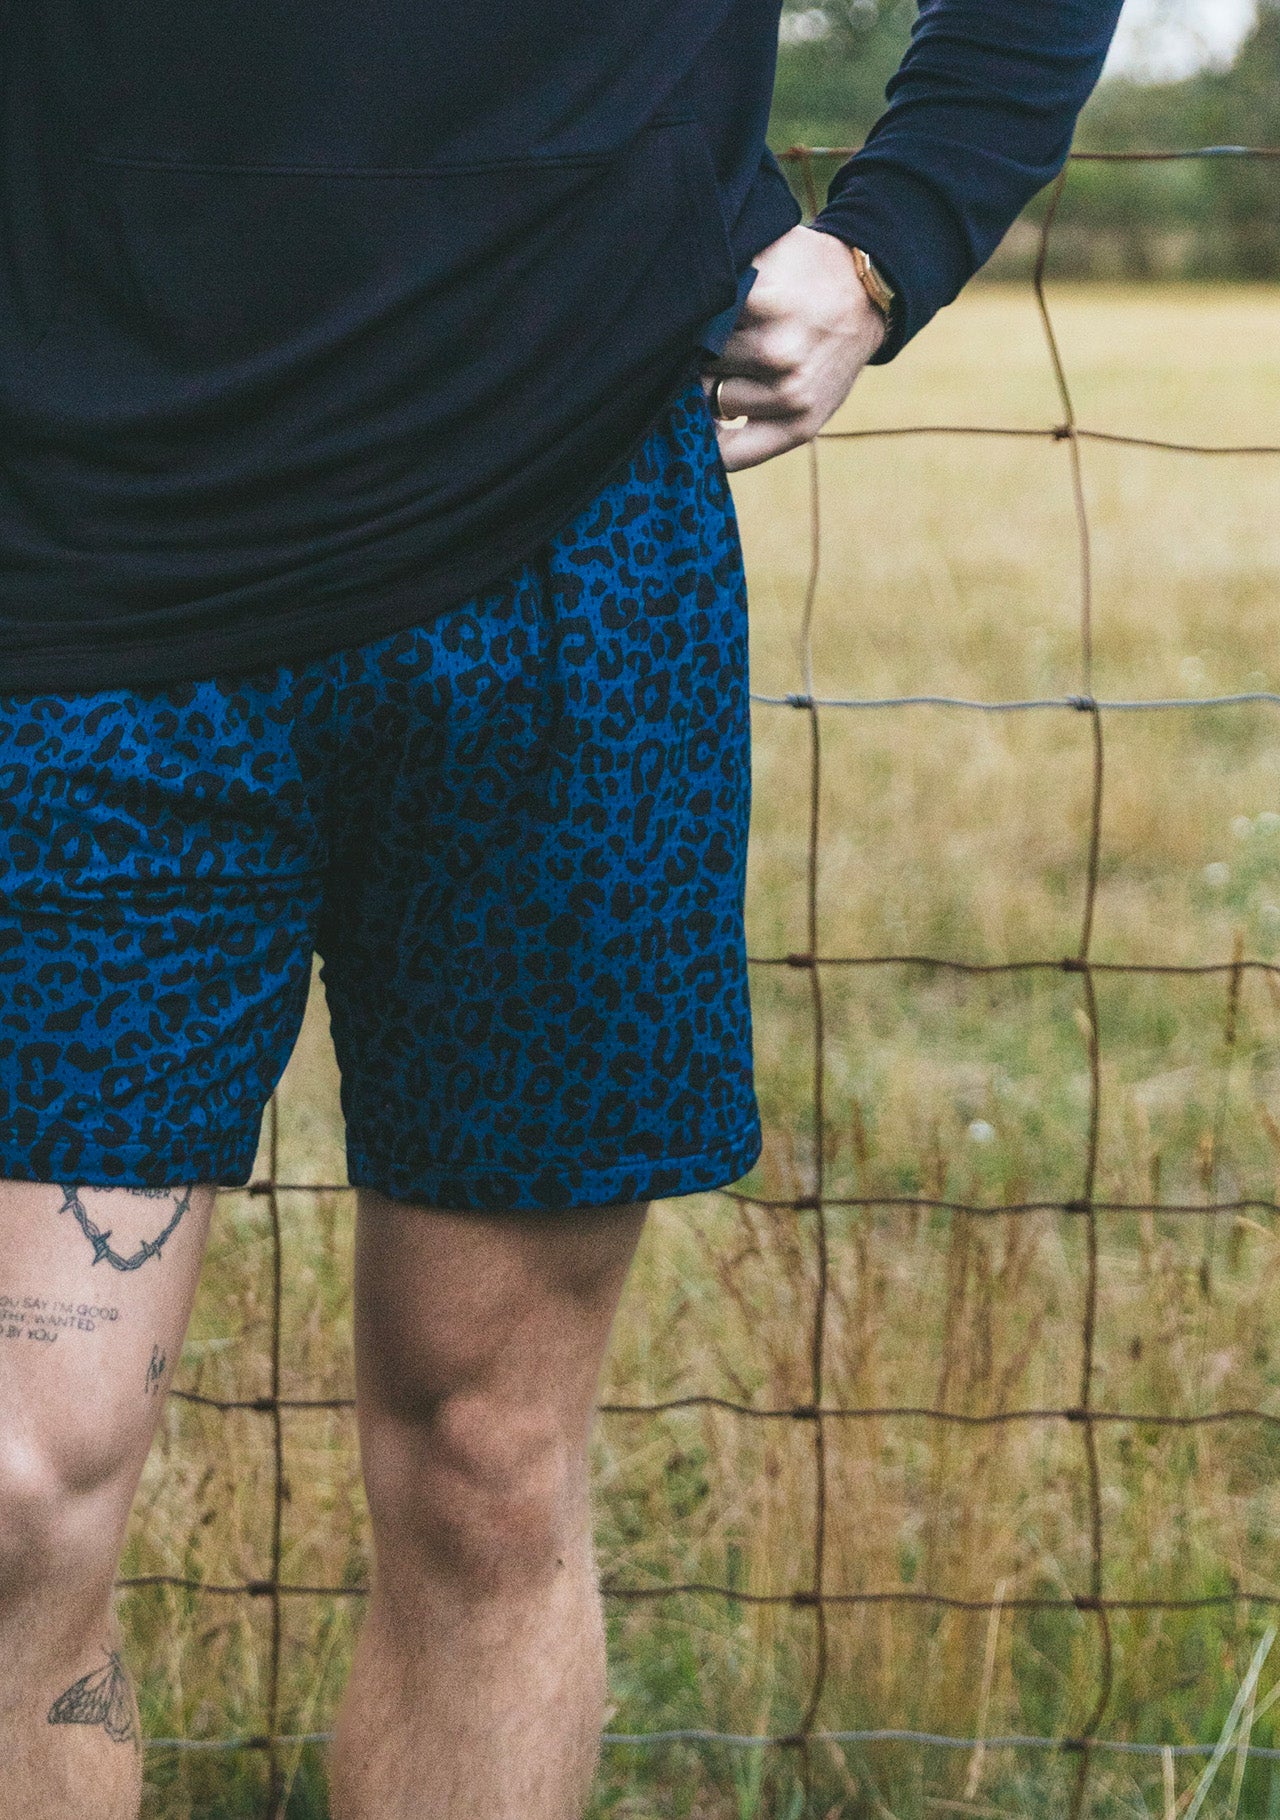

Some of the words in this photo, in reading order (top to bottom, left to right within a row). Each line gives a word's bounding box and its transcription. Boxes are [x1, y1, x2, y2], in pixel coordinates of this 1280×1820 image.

[23, 1297, 48, 1312] SAY
[77, 1303, 119, 1321] GOOD
[35, 1314, 95, 1332] WANTED
[5, 1325, 24, 1339] BY
[27, 1327, 59, 1343] YOU
